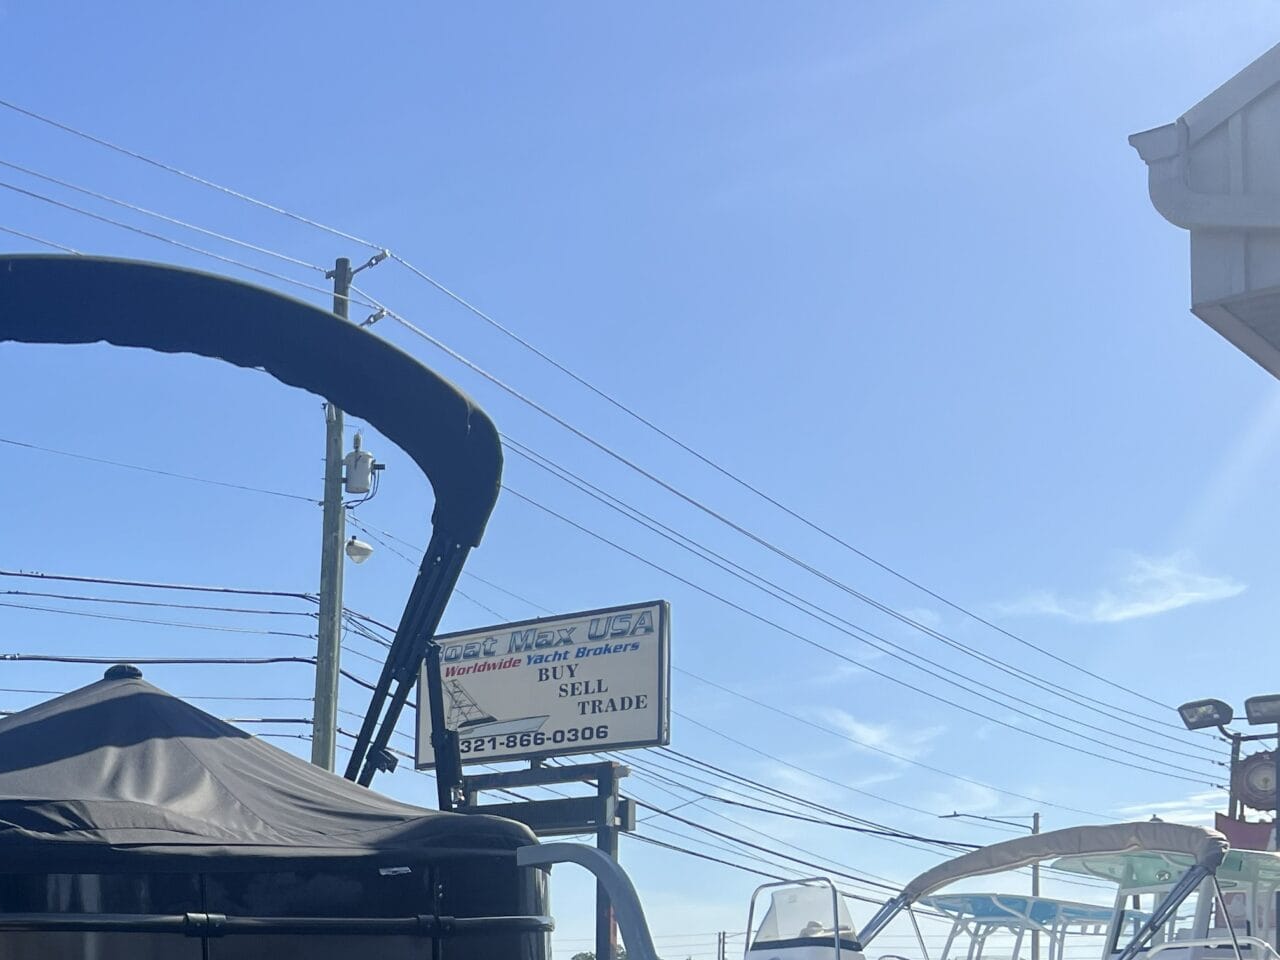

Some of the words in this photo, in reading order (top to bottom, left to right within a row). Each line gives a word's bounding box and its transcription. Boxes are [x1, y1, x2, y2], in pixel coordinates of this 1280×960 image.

[507, 627, 577, 654] Max
[587, 610, 655, 641] USA
[445, 657, 522, 677] Worldwide
[525, 650, 570, 666] Yacht
[574, 641, 640, 659] Brokers
[537, 663, 579, 682] BUY
[558, 679, 609, 698] SELL
[577, 694, 648, 715] TRADE
[460, 725, 609, 754] 321-866-0306
